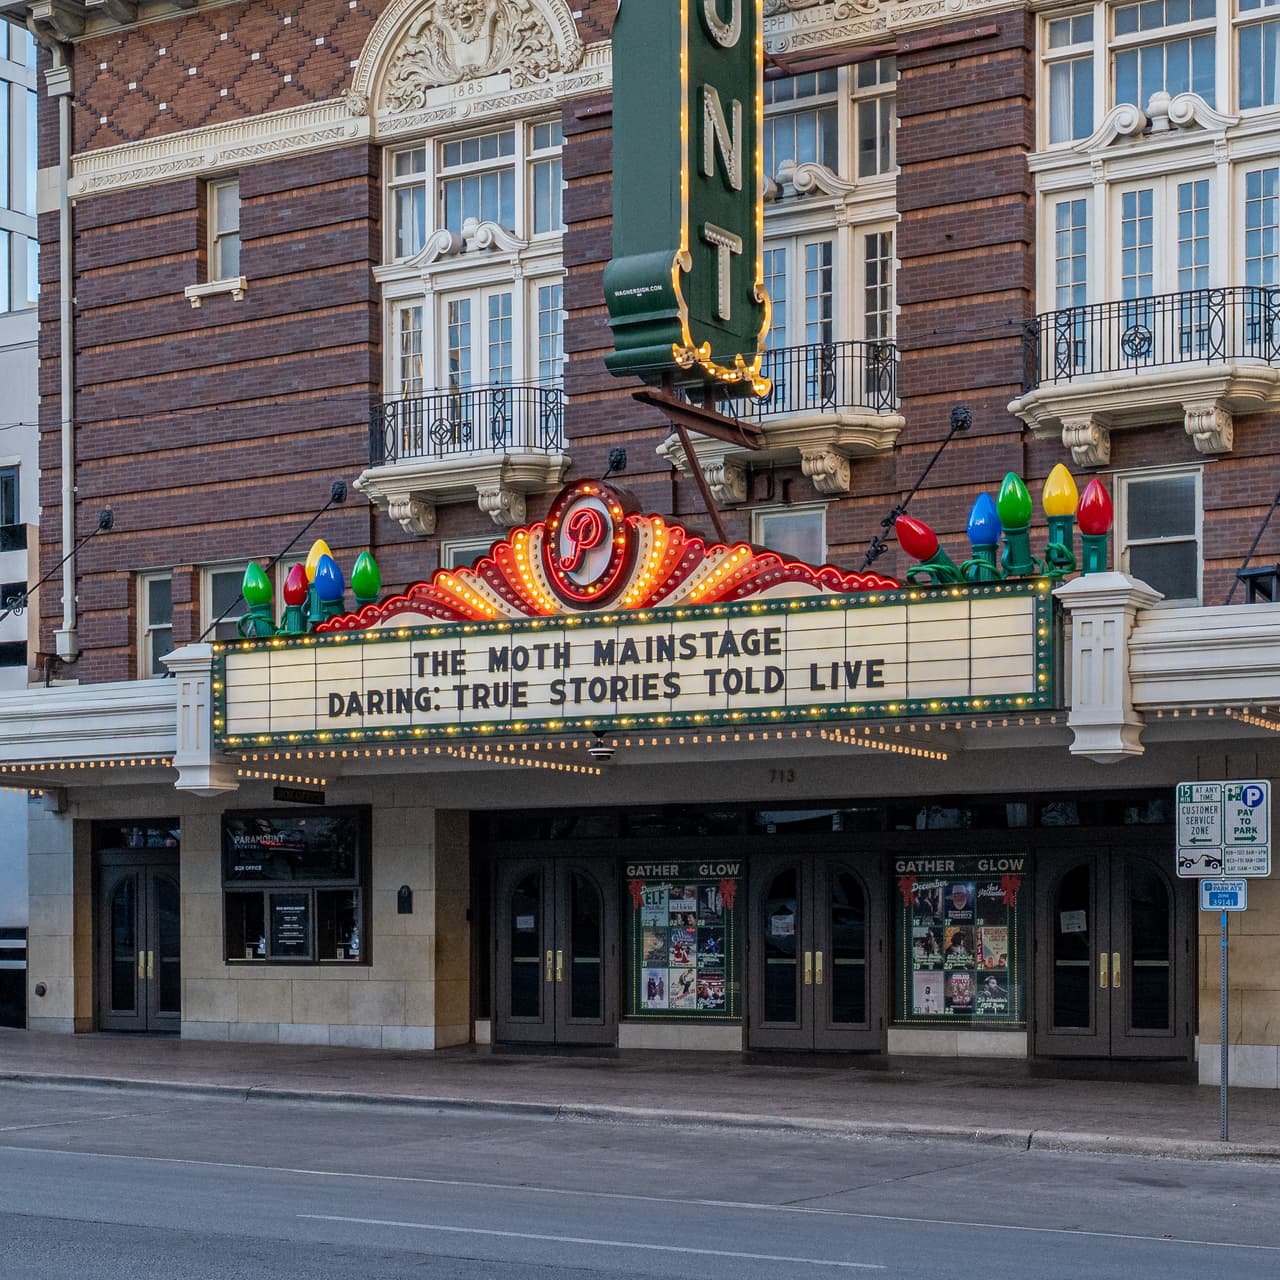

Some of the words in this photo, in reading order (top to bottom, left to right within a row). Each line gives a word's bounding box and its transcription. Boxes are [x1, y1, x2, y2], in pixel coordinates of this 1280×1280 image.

[453, 81, 484, 99] 1885
[413, 649, 466, 678] THE
[488, 641, 571, 672] MOTH
[593, 626, 782, 667] MAINSTAGE
[328, 686, 441, 718] DARING:
[452, 681, 529, 711] TRUE
[549, 671, 681, 705] STORIES
[703, 665, 785, 696] TOLD
[809, 658, 885, 691] LIVE
[769, 768, 794, 783] 713
[1180, 785, 1190, 797] 15
[1182, 805, 1218, 815] CUSTOMER
[1185, 816, 1215, 825] SERVICE
[1191, 826, 1209, 835] ZONE
[233, 833, 285, 844] PARAMOUNT
[626, 865, 680, 876] GATHER
[698, 863, 740, 876] GLOW
[895, 859, 955, 872] GATHER
[977, 858, 1024, 871] GLOW
[645, 890, 665, 905] ELF
